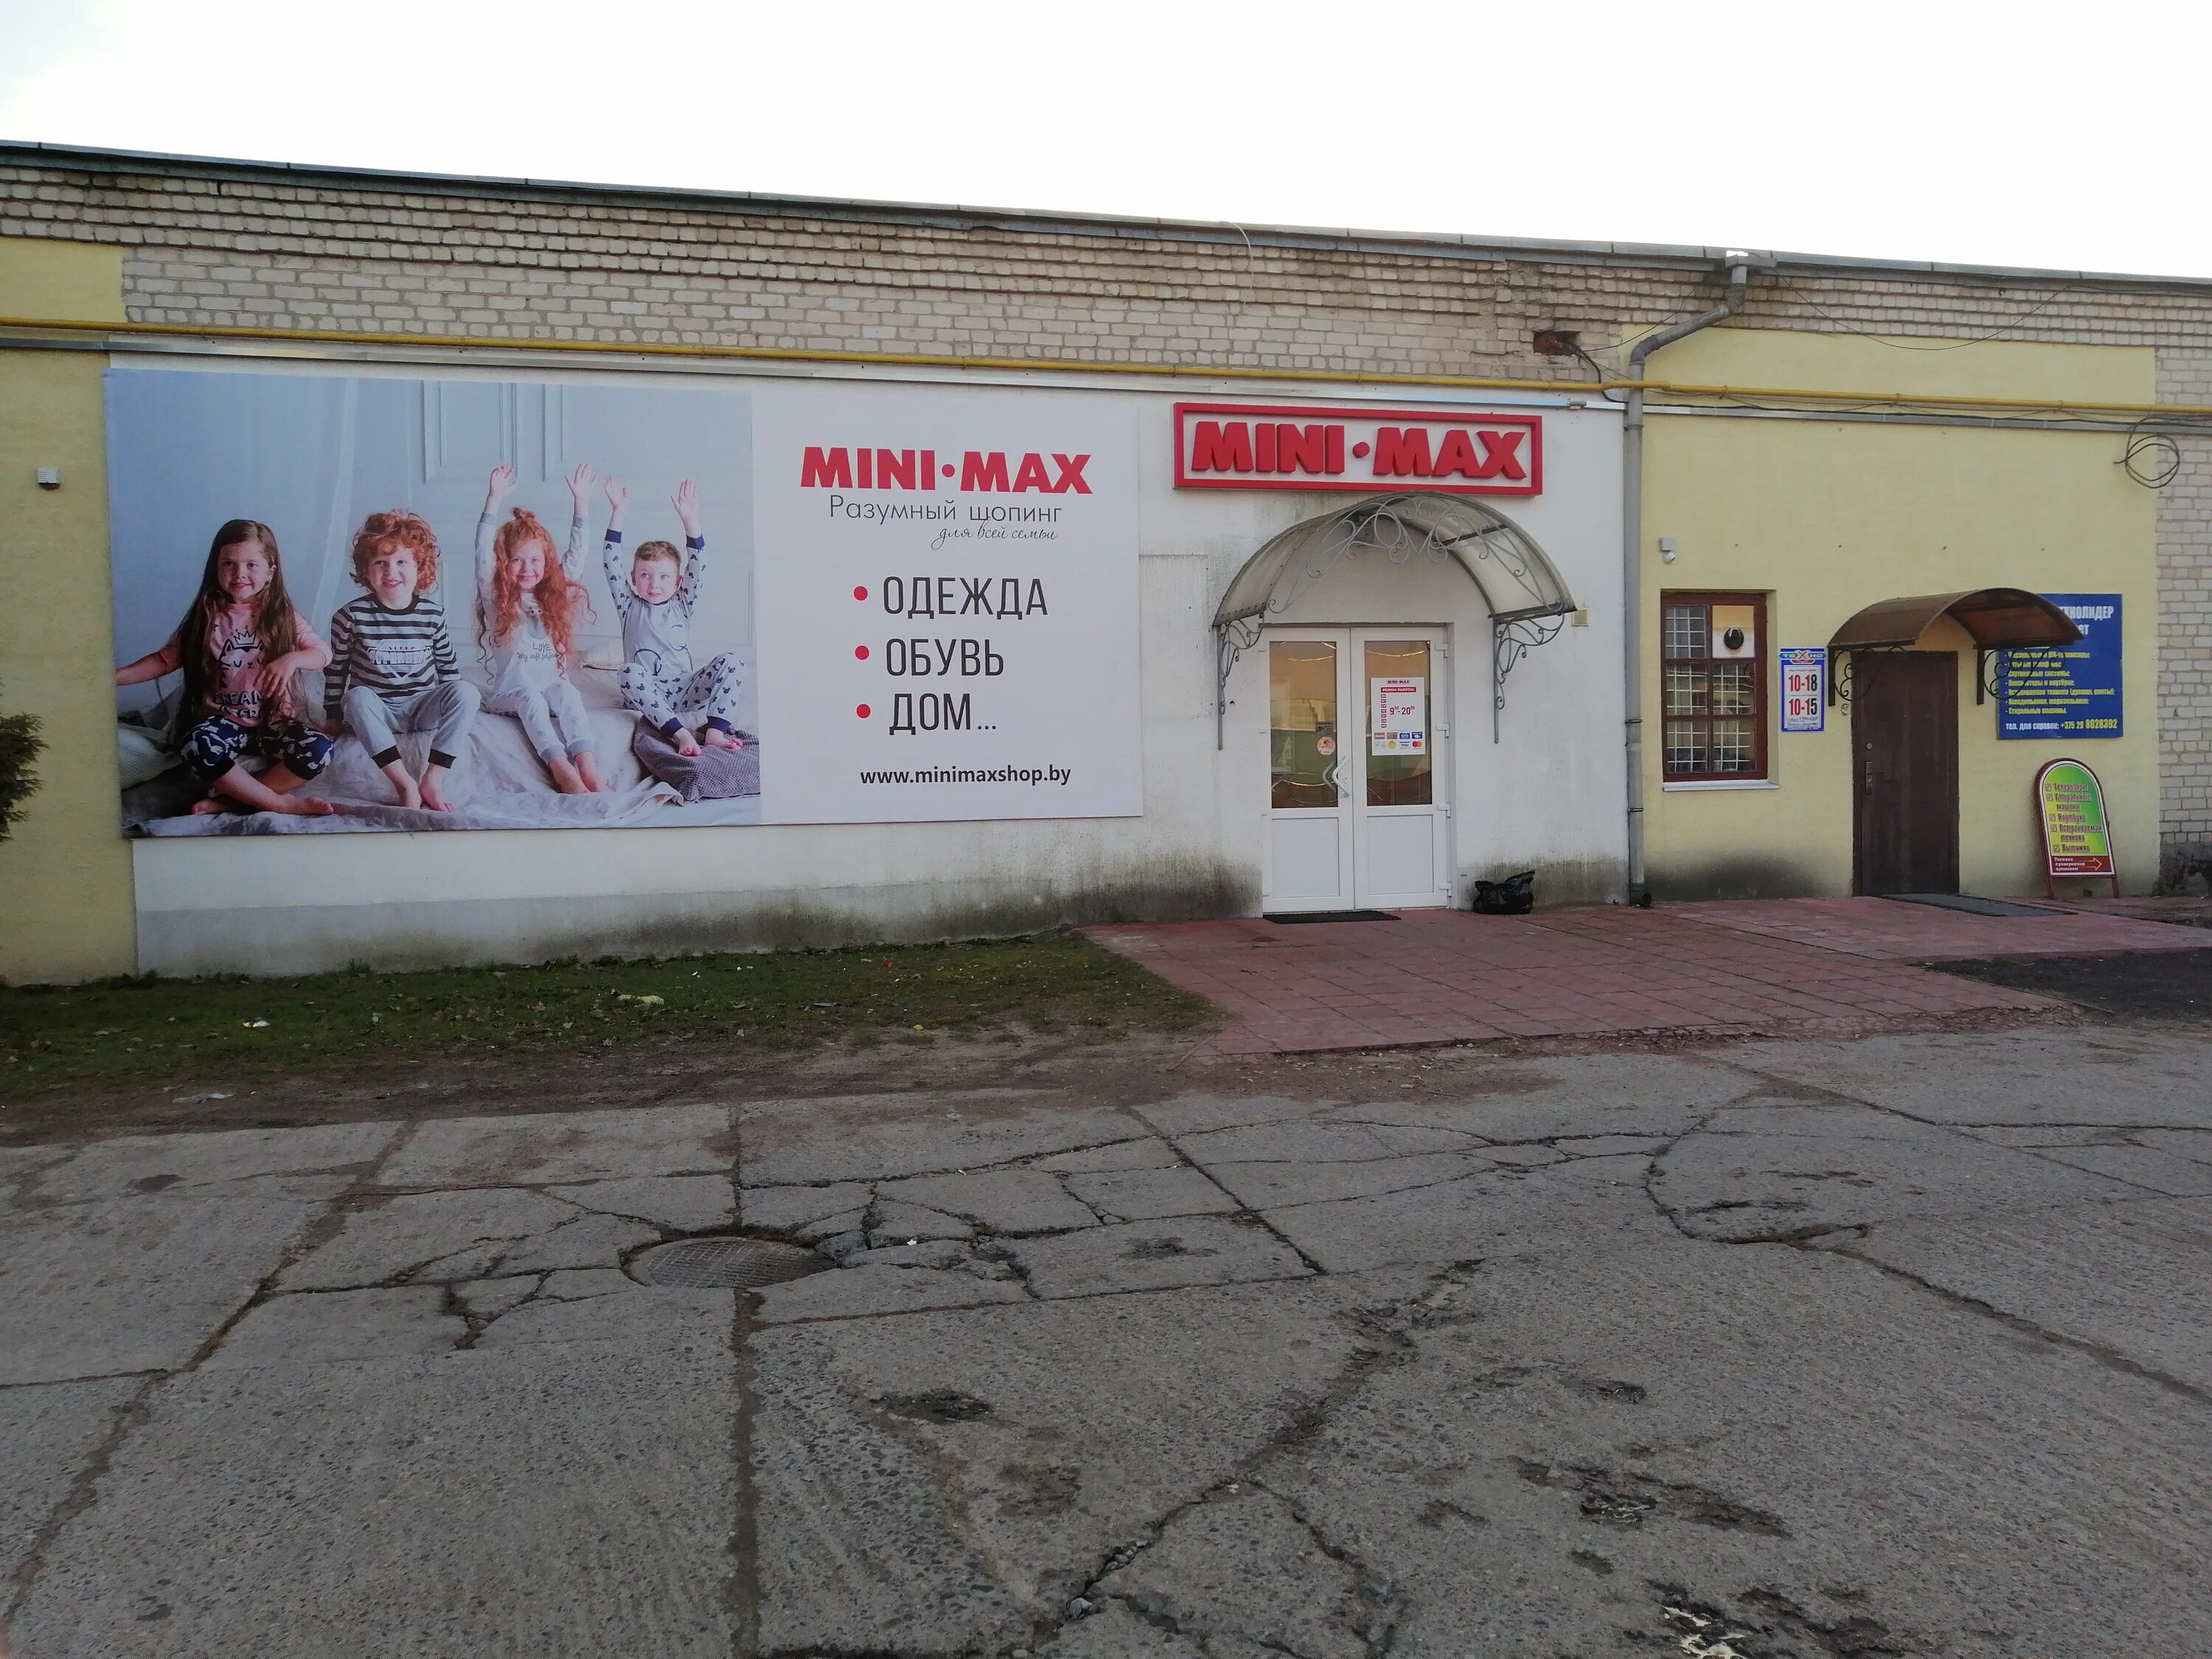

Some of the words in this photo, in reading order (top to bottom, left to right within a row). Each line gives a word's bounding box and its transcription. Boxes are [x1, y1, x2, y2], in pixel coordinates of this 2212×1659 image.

[830, 495, 956, 524] Разумный
[970, 505, 1062, 523] шопинг
[931, 524, 974, 550] для
[977, 515, 1009, 539] всей
[1011, 529, 1058, 540] семьи
[882, 576, 1049, 619] ОДЕЖДА
[532, 642, 552, 653] LOVE
[885, 638, 1004, 677] ОБУВЬ
[1788, 674, 1818, 692] 10-18
[888, 692, 997, 736] ДОМ...
[1788, 698, 1818, 716] 10-15
[2061, 721, 2075, 729] +375
[2076, 721, 2084, 729] 29
[860, 765, 1071, 786] www.minimaxshop.by
[2053, 783, 2088, 793] Телевизоры
[2055, 793, 2091, 803] Стиральные
[2058, 813, 2086, 824] Ноутбуки
[2059, 824, 2103, 834] Встраиваемая
[2062, 844, 2090, 852] Вытяжки
